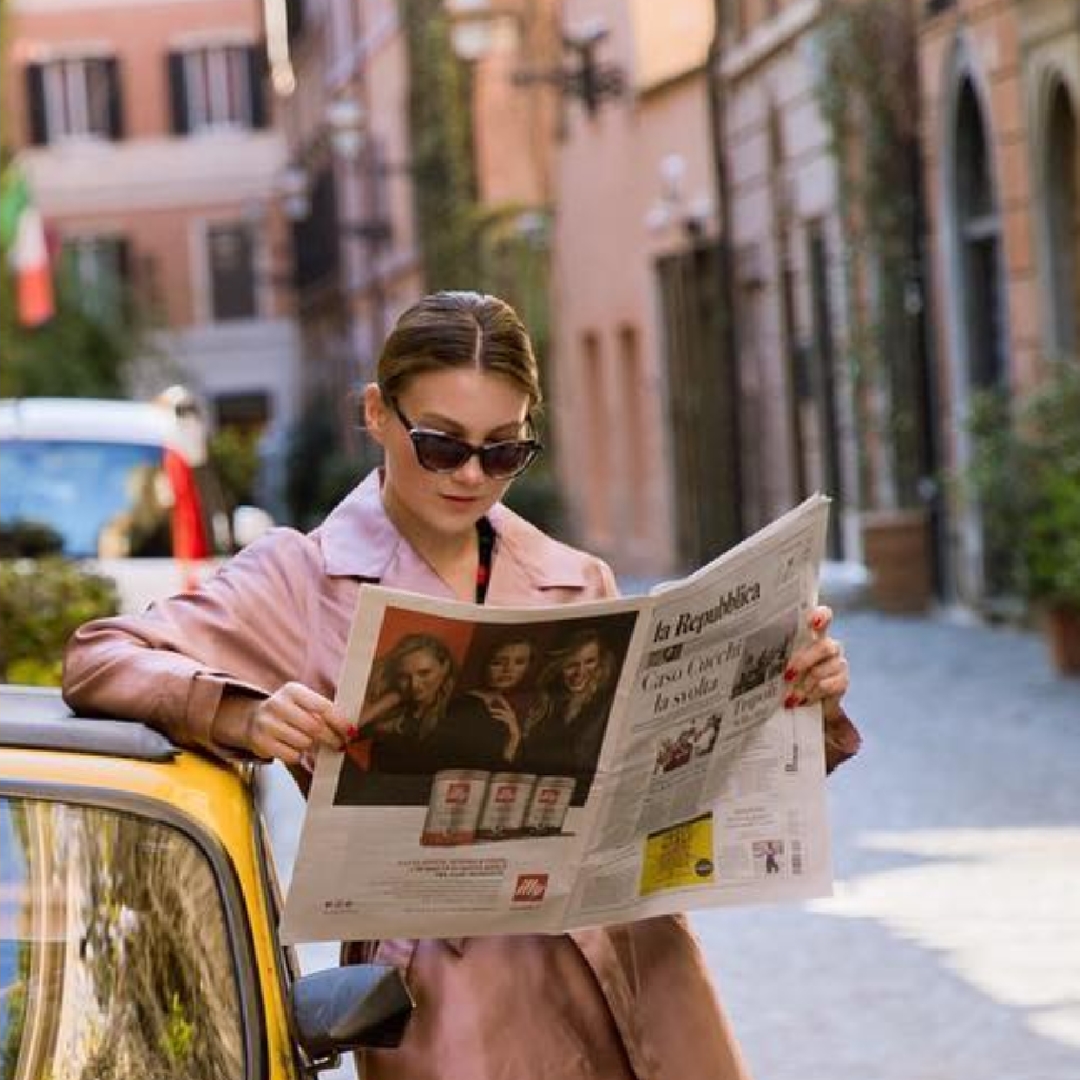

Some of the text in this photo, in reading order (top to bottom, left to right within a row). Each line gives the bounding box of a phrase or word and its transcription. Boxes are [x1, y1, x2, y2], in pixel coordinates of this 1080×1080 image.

[653, 582, 761, 643] la Repubblica
[653, 694, 669, 714] la
